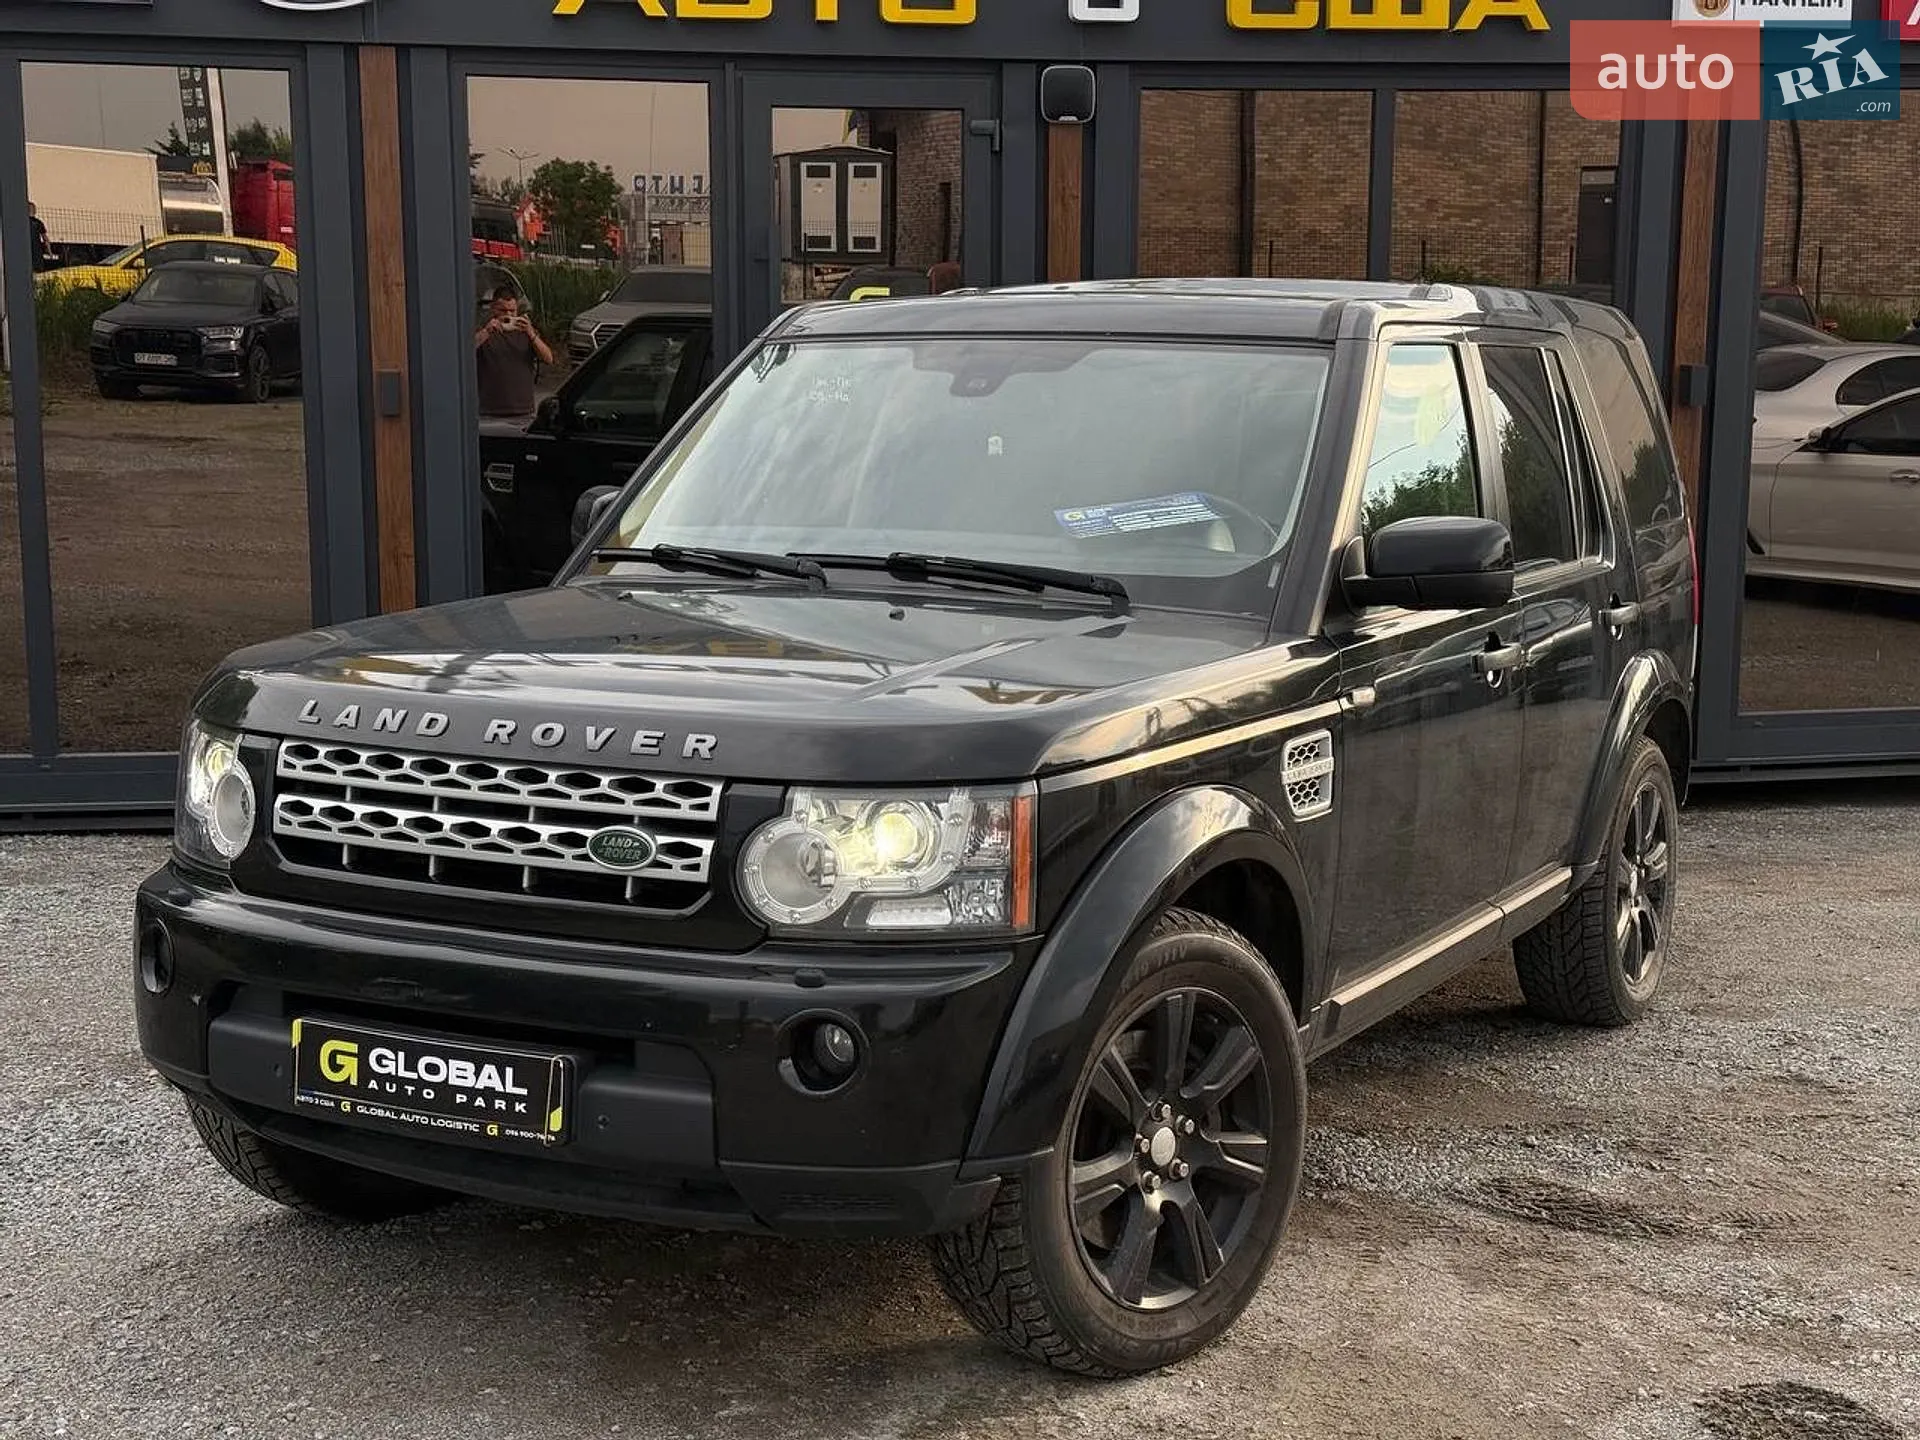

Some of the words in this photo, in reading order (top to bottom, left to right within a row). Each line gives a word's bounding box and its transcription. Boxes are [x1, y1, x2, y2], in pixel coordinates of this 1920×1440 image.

[297, 699, 450, 738] LAND
[483, 718, 719, 760] ROVER
[602, 835, 632, 848] LAND
[603, 847, 642, 860] ROVER
[368, 1046, 528, 1096] GLOBAL
[368, 1079, 436, 1100] AUTO
[455, 1094, 528, 1114] PARK
[356, 1104, 398, 1120] GLOBAL
[399, 1111, 429, 1125] AUTO
[430, 1116, 480, 1133] LOGISTIC
